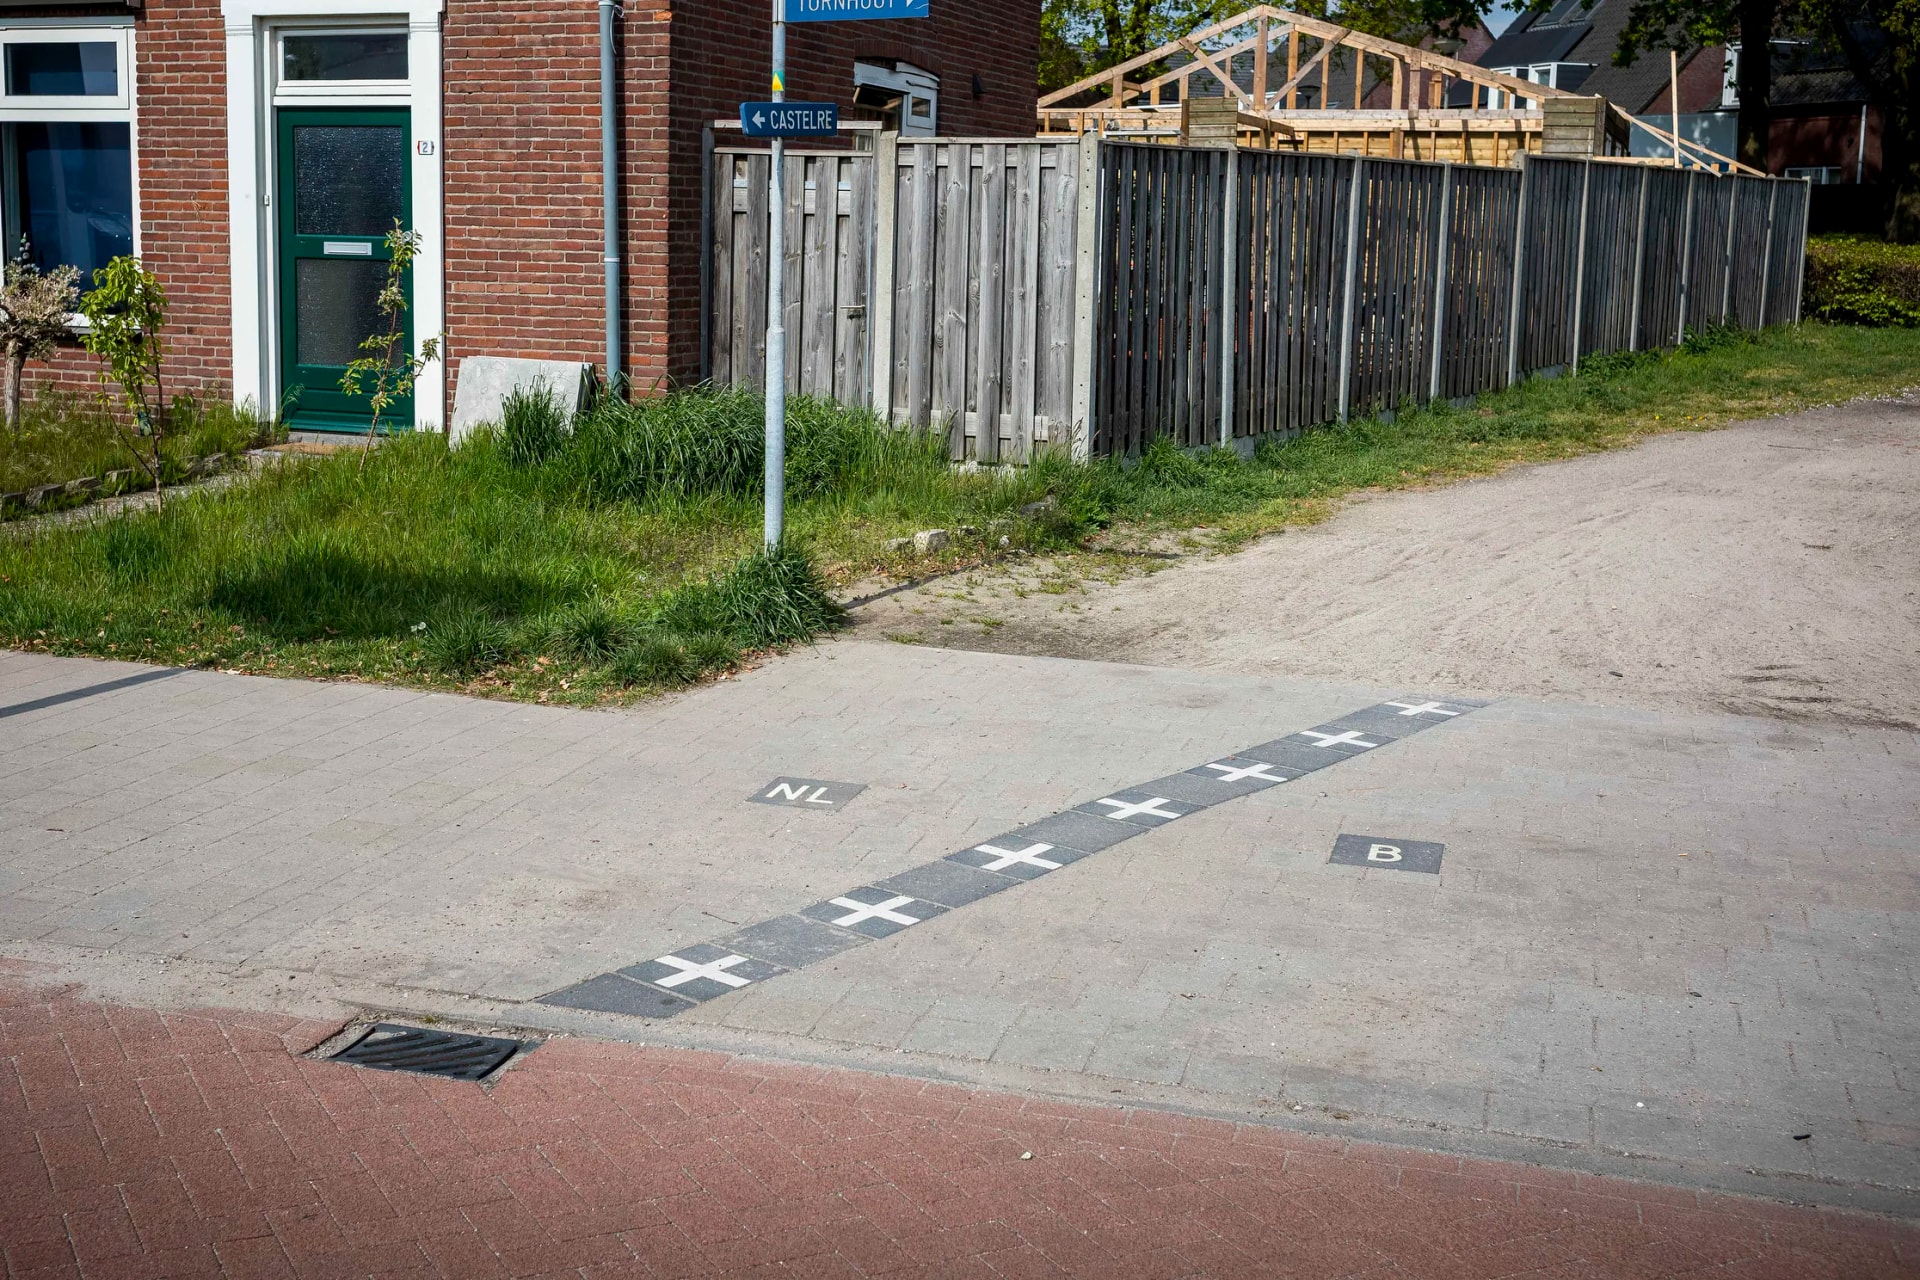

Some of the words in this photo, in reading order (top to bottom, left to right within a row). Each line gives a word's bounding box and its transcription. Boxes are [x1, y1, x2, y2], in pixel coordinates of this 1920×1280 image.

[770, 109, 833, 130] CASTELRE
[422, 142, 428, 153] 2
[765, 783, 834, 804] NL
[1367, 843, 1403, 862] B
